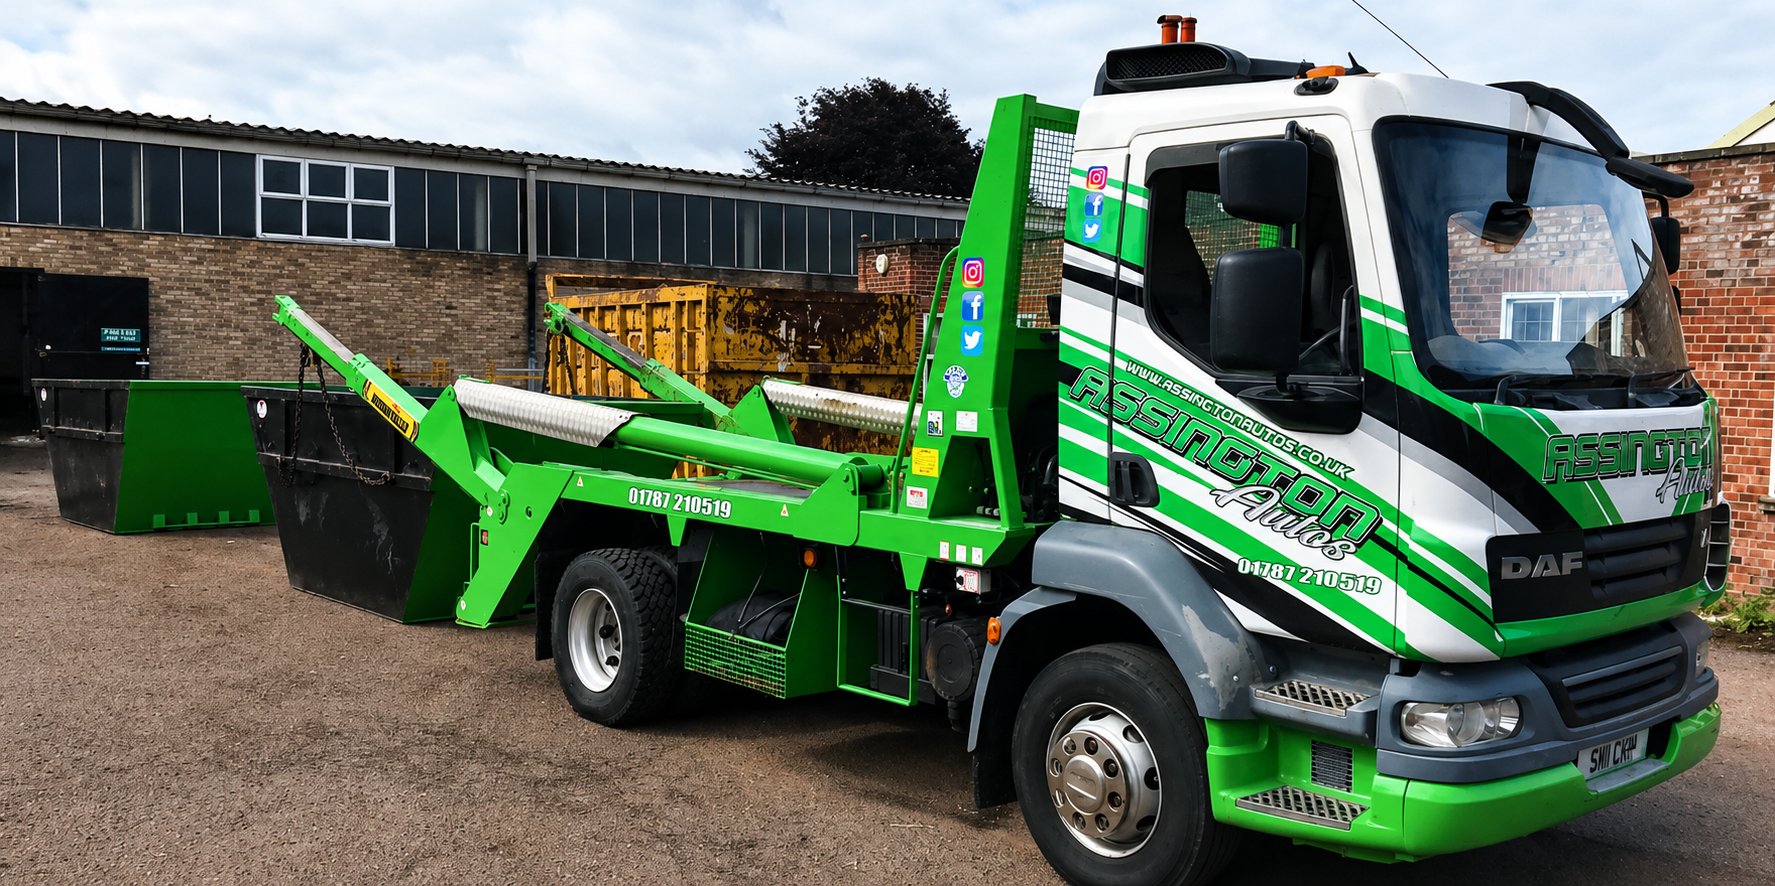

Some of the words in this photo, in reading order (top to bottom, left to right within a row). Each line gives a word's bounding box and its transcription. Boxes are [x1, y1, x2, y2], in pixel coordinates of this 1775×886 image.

[1069, 366, 1382, 549] ASSINGTON
[628, 487, 671, 509] 01787
[672, 493, 732, 519] 210519
[1209, 484, 1357, 561] Autos
[1237, 557, 1296, 581] 01787
[1298, 566, 1383, 595] 210519
[1501, 551, 1583, 580] DAF
